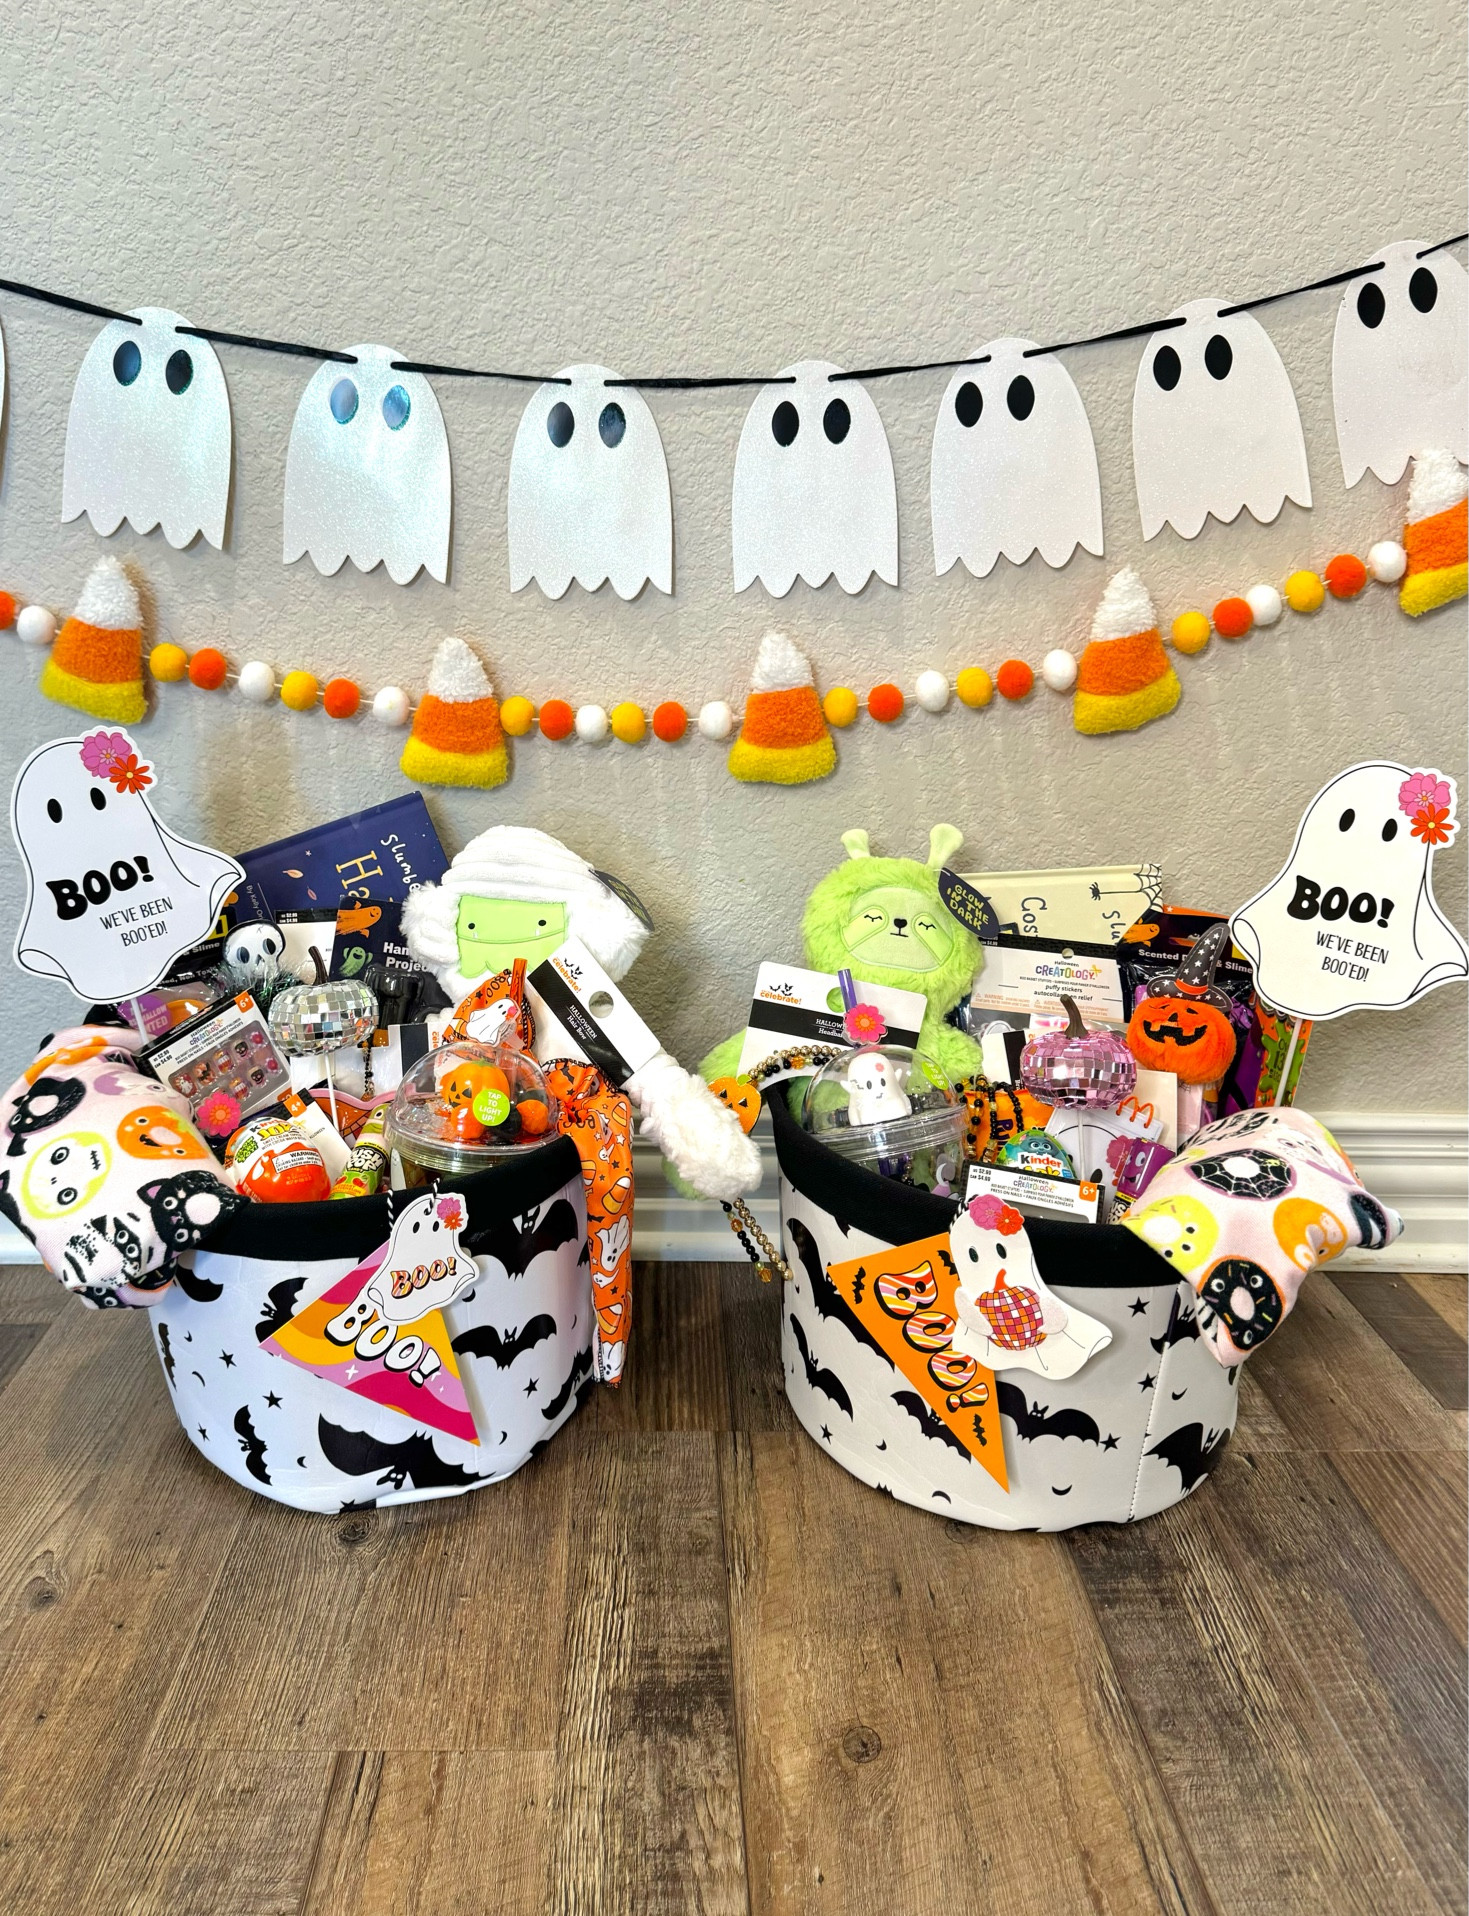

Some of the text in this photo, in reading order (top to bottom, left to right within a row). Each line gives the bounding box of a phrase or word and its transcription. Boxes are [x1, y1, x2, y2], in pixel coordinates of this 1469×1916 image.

[46, 856, 154, 920] BOO!
[955, 885, 984, 909] GLOW
[946, 888, 989, 925] IN THE
[1287, 875, 1395, 928] BOO!
[99, 897, 173, 930] WE'VE BEEN
[950, 900, 982, 930] DARK
[1021, 897, 1047, 937] Cos
[120, 920, 169, 947] BOO'ED!
[192, 942, 220, 954] Slime
[383, 942, 409, 956] Han
[1138, 949, 1179, 961] Scented
[1316, 931, 1389, 964] WE'VE BEEN
[386, 958, 428, 973] Projec
[552, 957, 582, 993] celebrate!
[1035, 965, 1095, 980] CREATOLOGY
[1225, 961, 1253, 974] Slime
[1321, 956, 1369, 982] BOO'ED!
[240, 997, 249, 1007] 6+
[760, 991, 802, 1005] celebrate!
[567, 1016, 586, 1040] Hair Bow
[569, 1004, 598, 1039] HALLOWEEN
[488, 1091, 501, 1100] TAP
[488, 1099, 498, 1107] TO
[291, 1101, 301, 1112] 4+
[479, 1105, 502, 1116] LIGHT
[347, 1157, 378, 1171] POP
[350, 1148, 383, 1167] USH
[1020, 1154, 1062, 1169] Kinder
[1019, 1175, 1049, 1185] Halloween
[1082, 1186, 1094, 1196] 6+
[390, 1257, 457, 1299] BOO!
[324, 1287, 441, 1388] BOO!
[874, 1260, 989, 1412] BOO!
